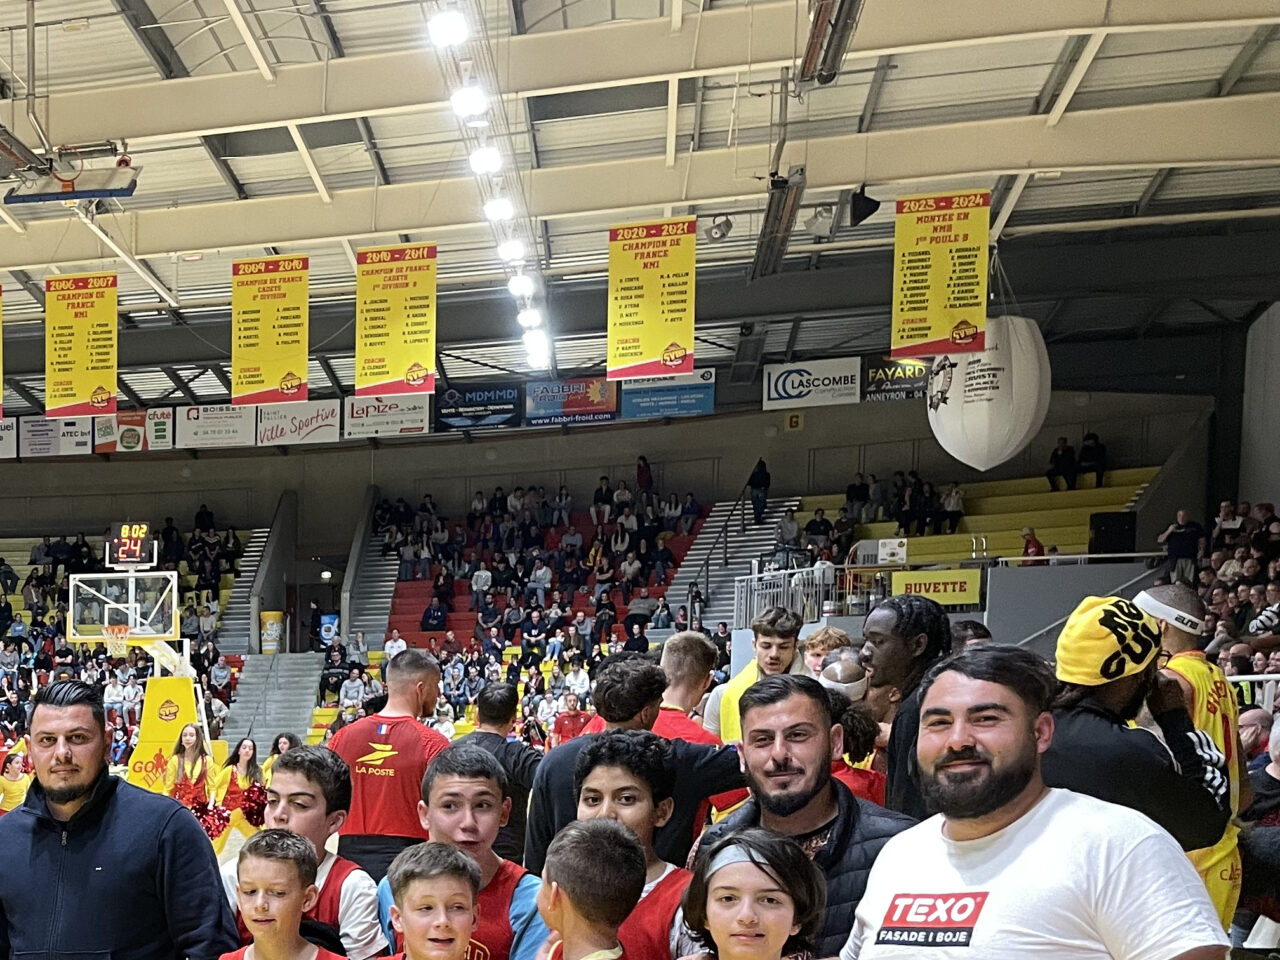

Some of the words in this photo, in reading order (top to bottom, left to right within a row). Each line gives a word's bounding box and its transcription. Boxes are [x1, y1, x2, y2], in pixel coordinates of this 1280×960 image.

[903, 198, 936, 213] 2023
[952, 194, 983, 209] 2024
[616, 227, 647, 240] 2020
[661, 222, 689, 236] 2021
[622, 240, 667, 252] CHAMPION
[670, 238, 682, 247] DE
[930, 234, 960, 244] POULE
[365, 251, 391, 263] 2010
[405, 247, 428, 260] 2011
[634, 250, 669, 261] FRANCE
[238, 262, 266, 275] 2009
[278, 259, 303, 271] 2010
[361, 267, 393, 276] CHAMPION
[405, 265, 431, 273] FRANCE
[50, 280, 75, 291] 2006
[88, 277, 114, 288] 2007
[278, 276, 303, 284] FRANCE
[66, 301, 96, 310] FRANCE
[868, 366, 926, 382] FAYARD
[791, 373, 857, 390] LASCOMBE
[533, 382, 586, 396] FABBRI
[350, 401, 399, 419] Lapize
[259, 424, 286, 444] Ville
[289, 407, 338, 436] Sportive
[531, 413, 611, 425] www.fabbri-froid.com
[789, 415, 800, 429] G
[120, 524, 148, 539] 8:02
[118, 539, 142, 559] 24
[904, 580, 968, 595] BUVETTE
[132, 759, 154, 773] GO
[355, 765, 368, 775] LA
[368, 767, 395, 777] POSTE
[891, 896, 977, 923] TEXO
[879, 930, 927, 943] FASADE
[928, 931, 933, 942] I
[935, 931, 969, 943] BOJE
